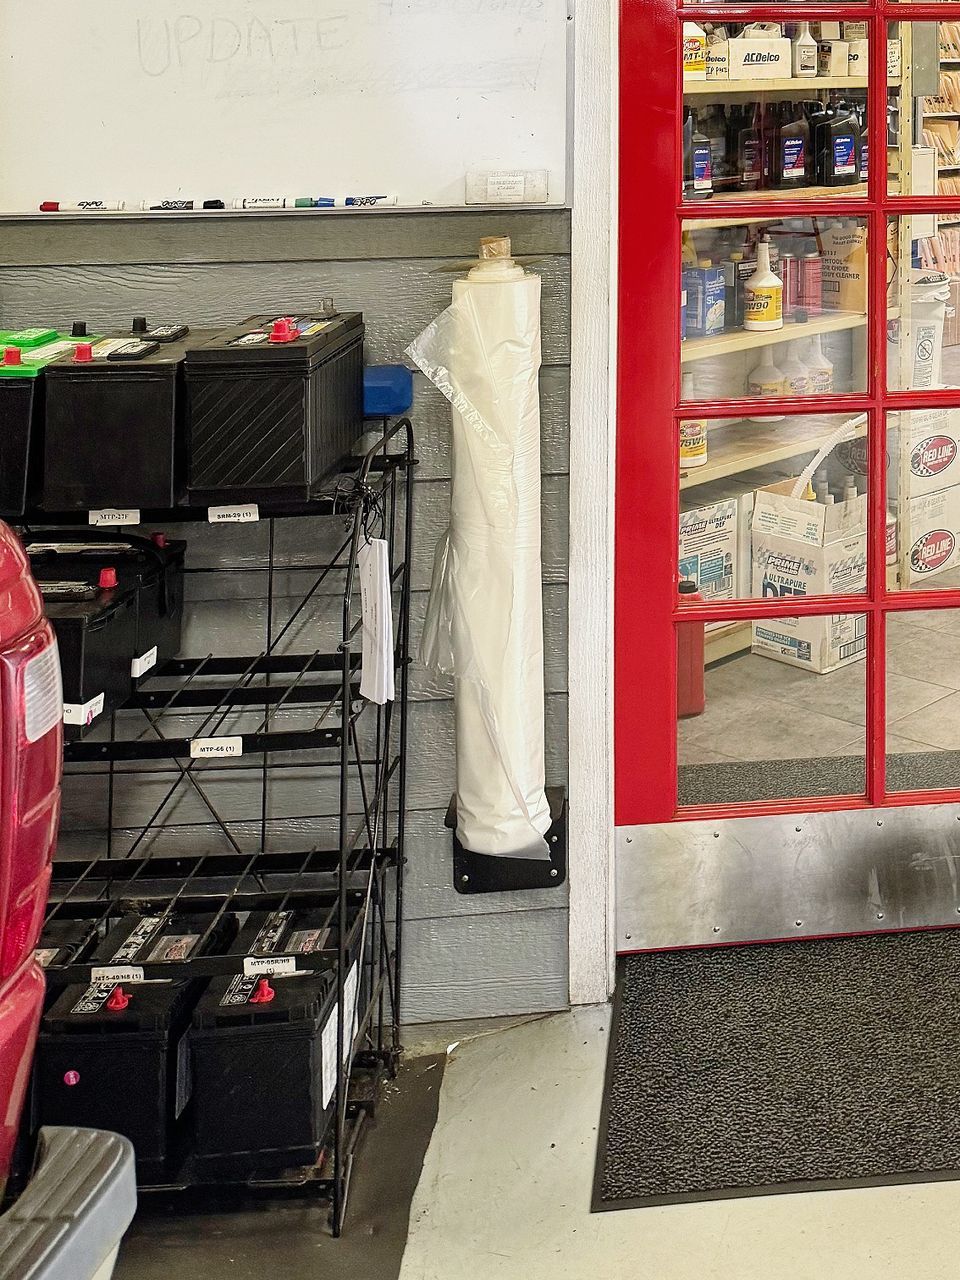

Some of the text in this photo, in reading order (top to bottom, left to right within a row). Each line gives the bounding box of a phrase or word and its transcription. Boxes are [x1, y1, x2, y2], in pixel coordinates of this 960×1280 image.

[136, 14, 349, 77] UPDATE
[743, 52, 780, 62] ACDelco
[77, 201, 103, 210] EXPO
[351, 197, 377, 207] EXPO
[767, 555, 801, 571] PRIME
[768, 573, 806, 591] ULTRAPURE
